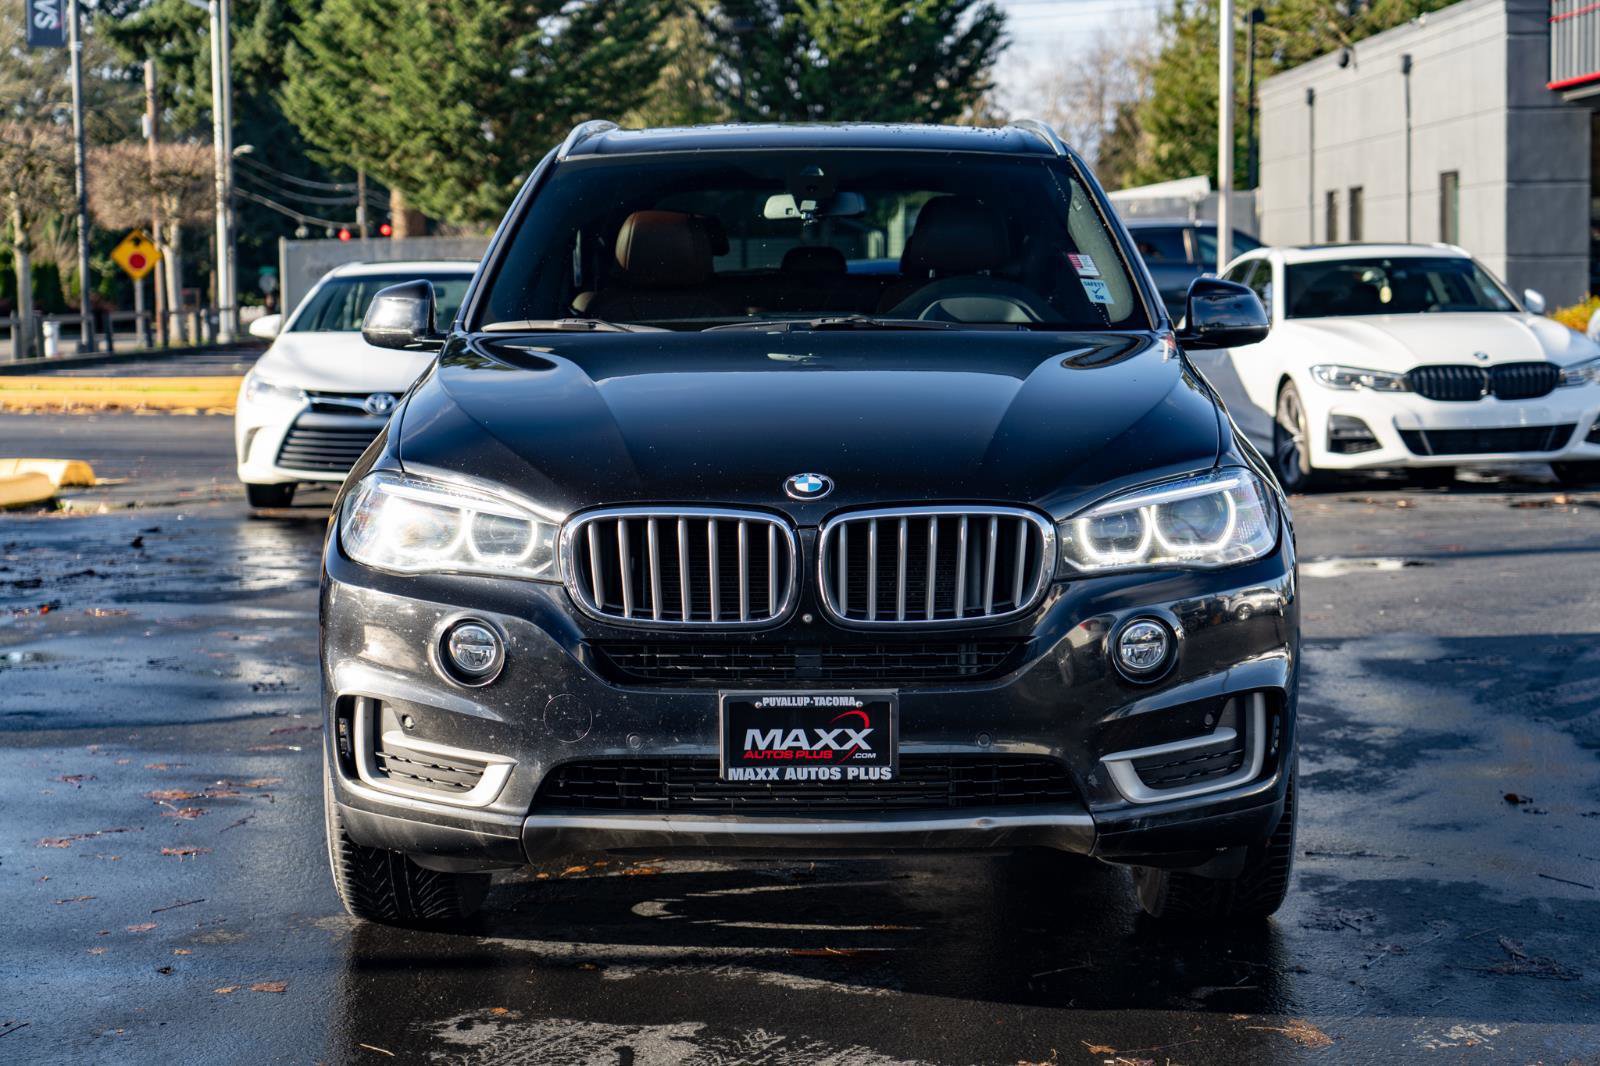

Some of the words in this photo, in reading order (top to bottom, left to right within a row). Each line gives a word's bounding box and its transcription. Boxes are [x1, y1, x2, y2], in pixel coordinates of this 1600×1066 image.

[744, 729, 874, 750] MAXX
[743, 750, 793, 759] AUTOS
[795, 750, 833, 759] PLUS
[728, 767, 780, 780] MAXX
[784, 767, 841, 780] AUTOS
[847, 767, 892, 780] PLUS
